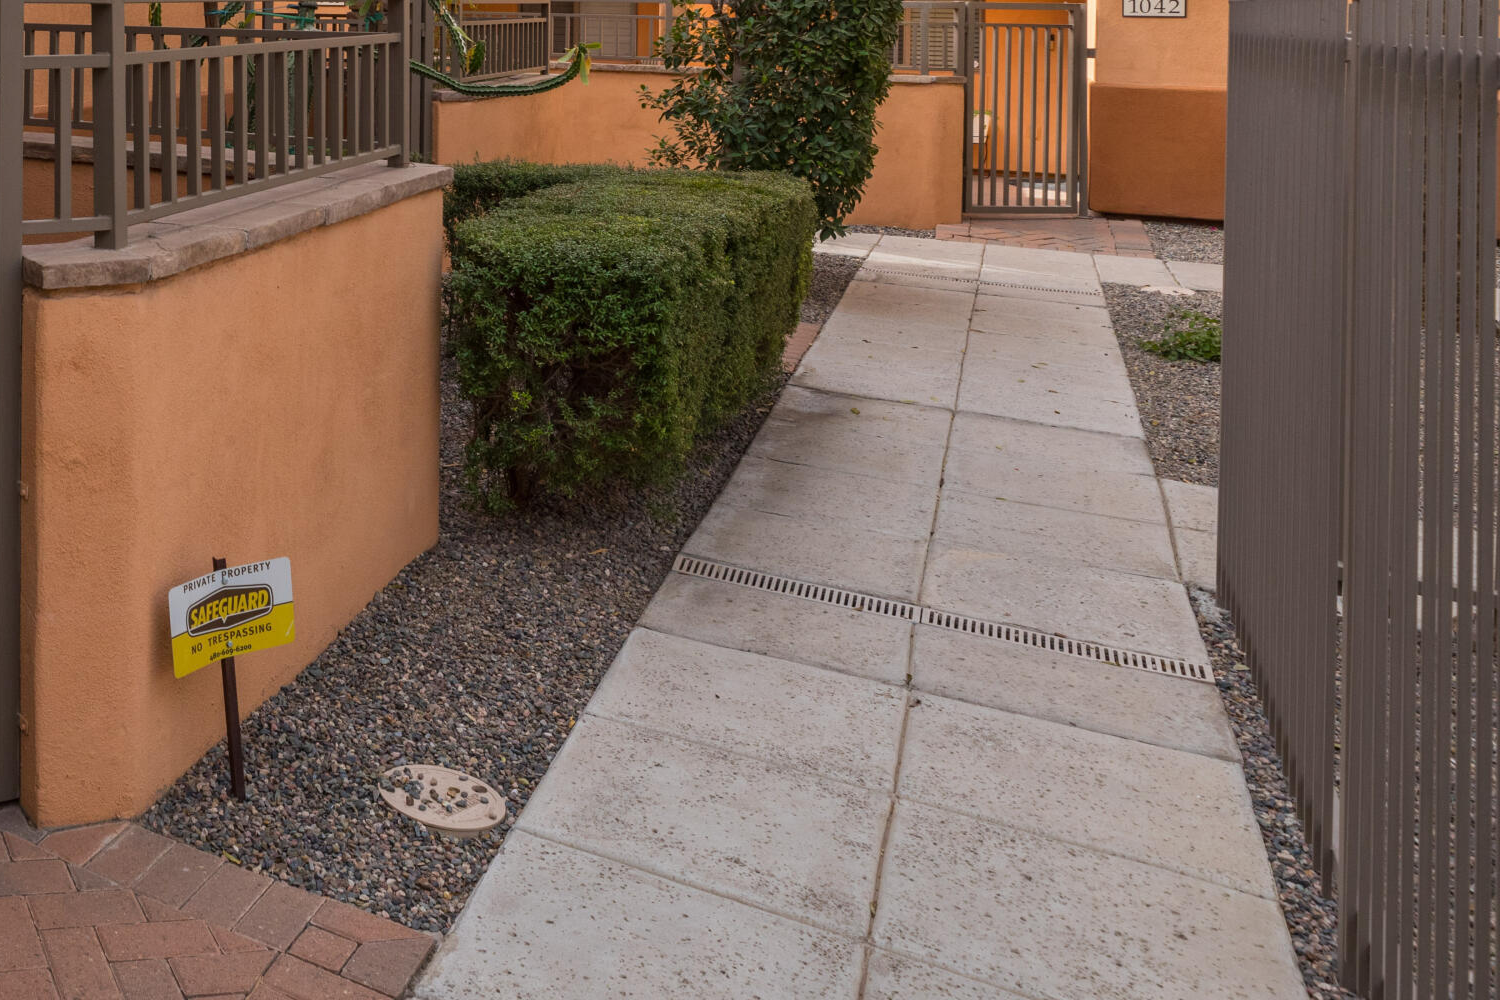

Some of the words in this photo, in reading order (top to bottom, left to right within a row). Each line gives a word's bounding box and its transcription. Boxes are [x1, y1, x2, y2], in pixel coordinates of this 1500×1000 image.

[183, 573, 216, 594] PRIVATE
[221, 561, 271, 577] PROPERTY
[190, 589, 269, 629] SAFEGUARD
[191, 642, 203, 655] NO
[207, 622, 273, 647] TRESPASSING
